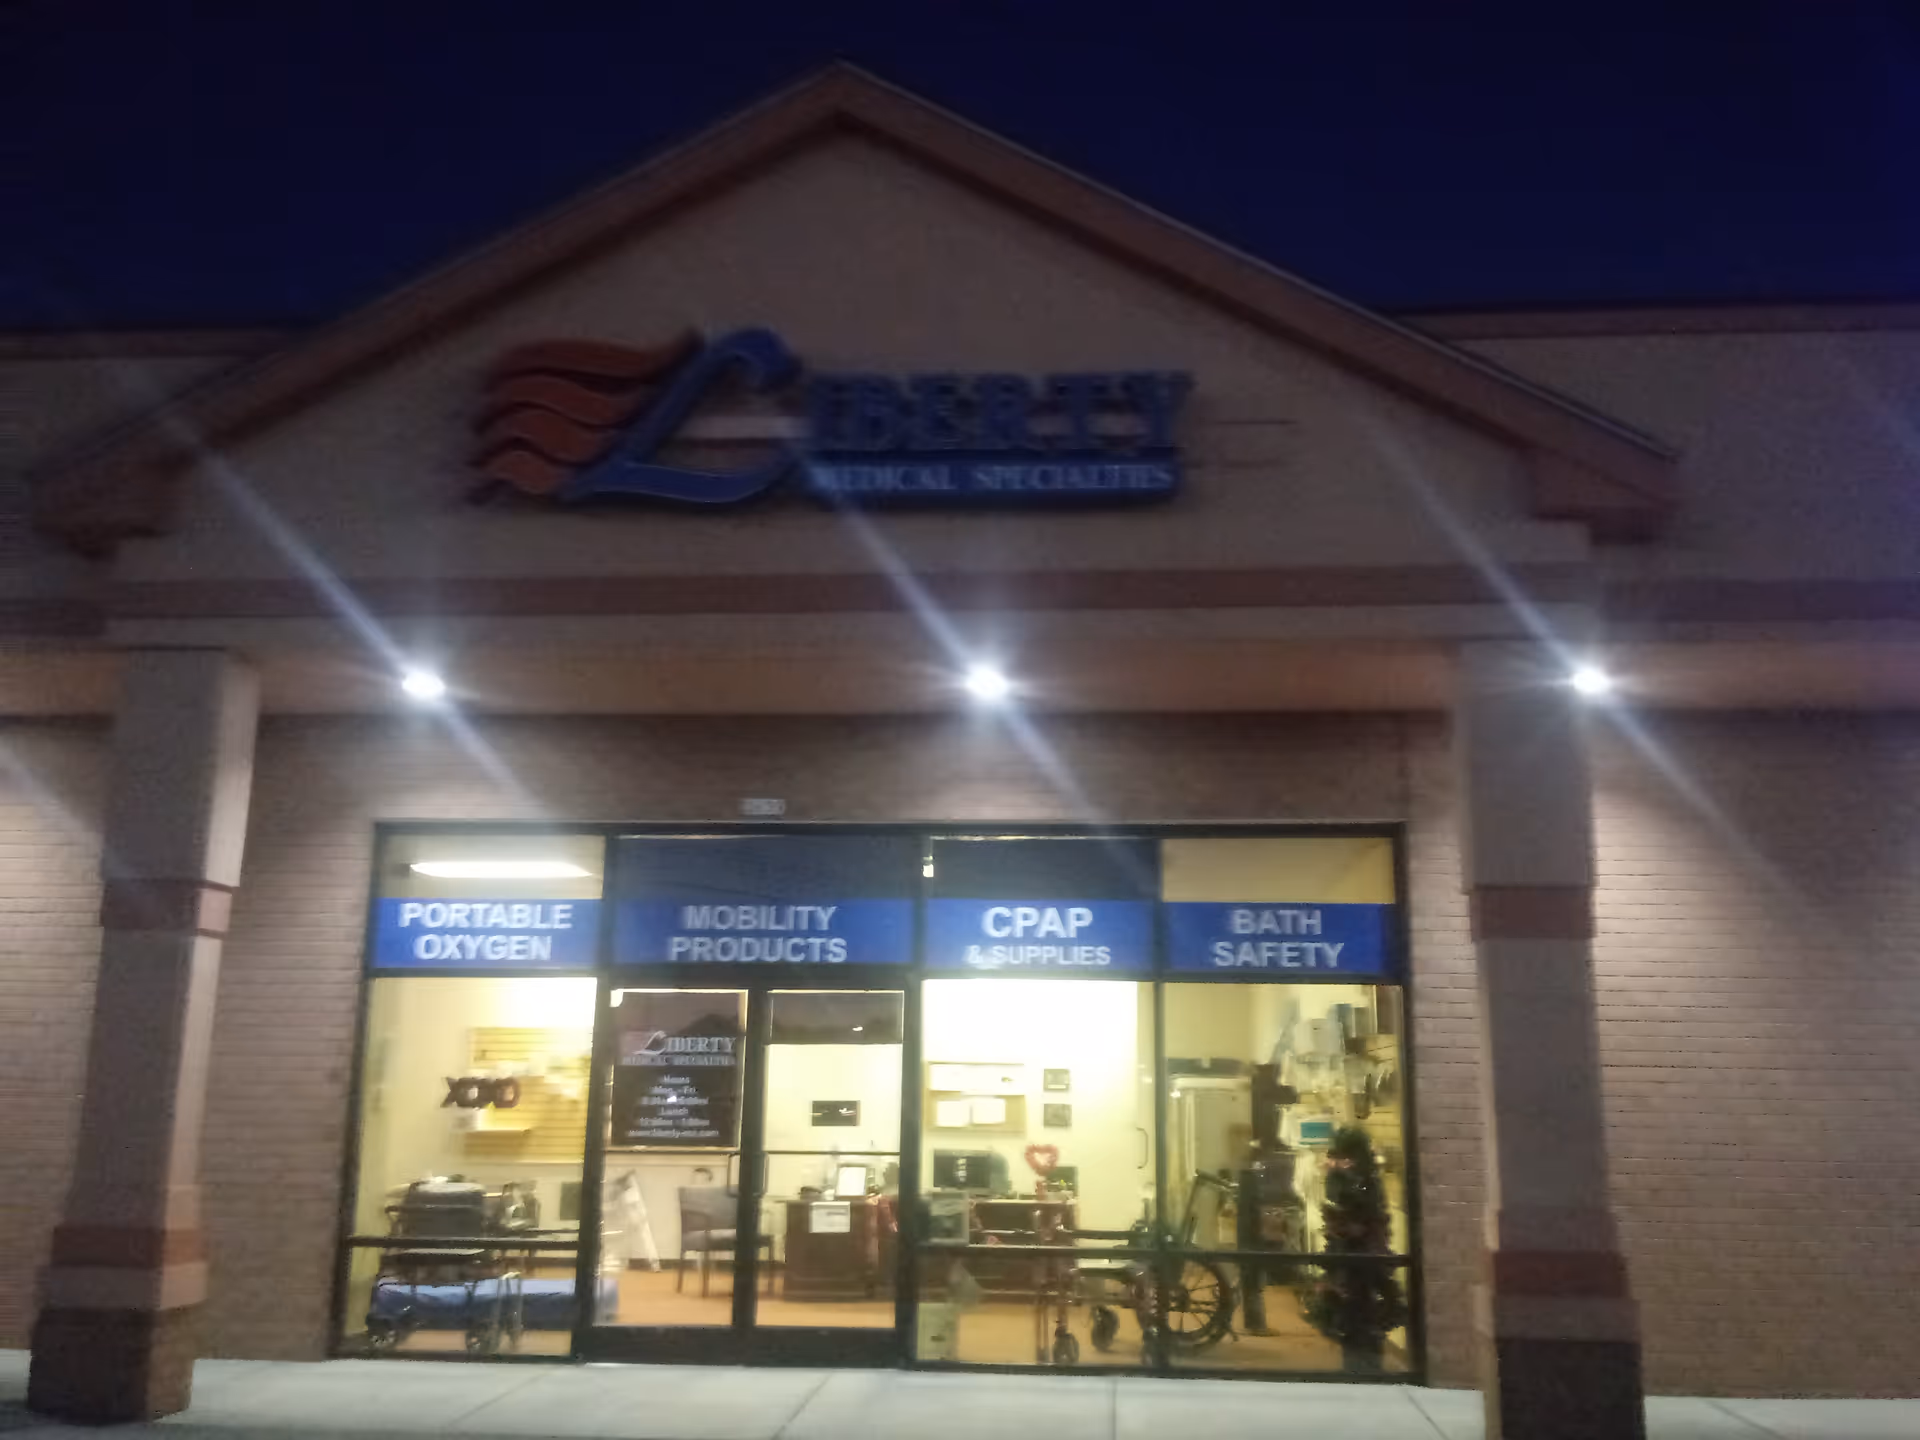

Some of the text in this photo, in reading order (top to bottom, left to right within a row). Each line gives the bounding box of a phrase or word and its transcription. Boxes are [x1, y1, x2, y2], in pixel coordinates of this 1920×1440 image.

[811, 464, 957, 490] MEDICAL
[399, 902, 574, 930] PORTABLE
[684, 905, 837, 931] MOBILITY
[981, 906, 1094, 939] CPAP
[1230, 909, 1323, 936] BATH
[413, 933, 553, 962] OXYGEN
[668, 936, 848, 964] PRODUCTS
[967, 944, 1112, 966] & SUPPLIES
[1213, 940, 1345, 969] SAFETY
